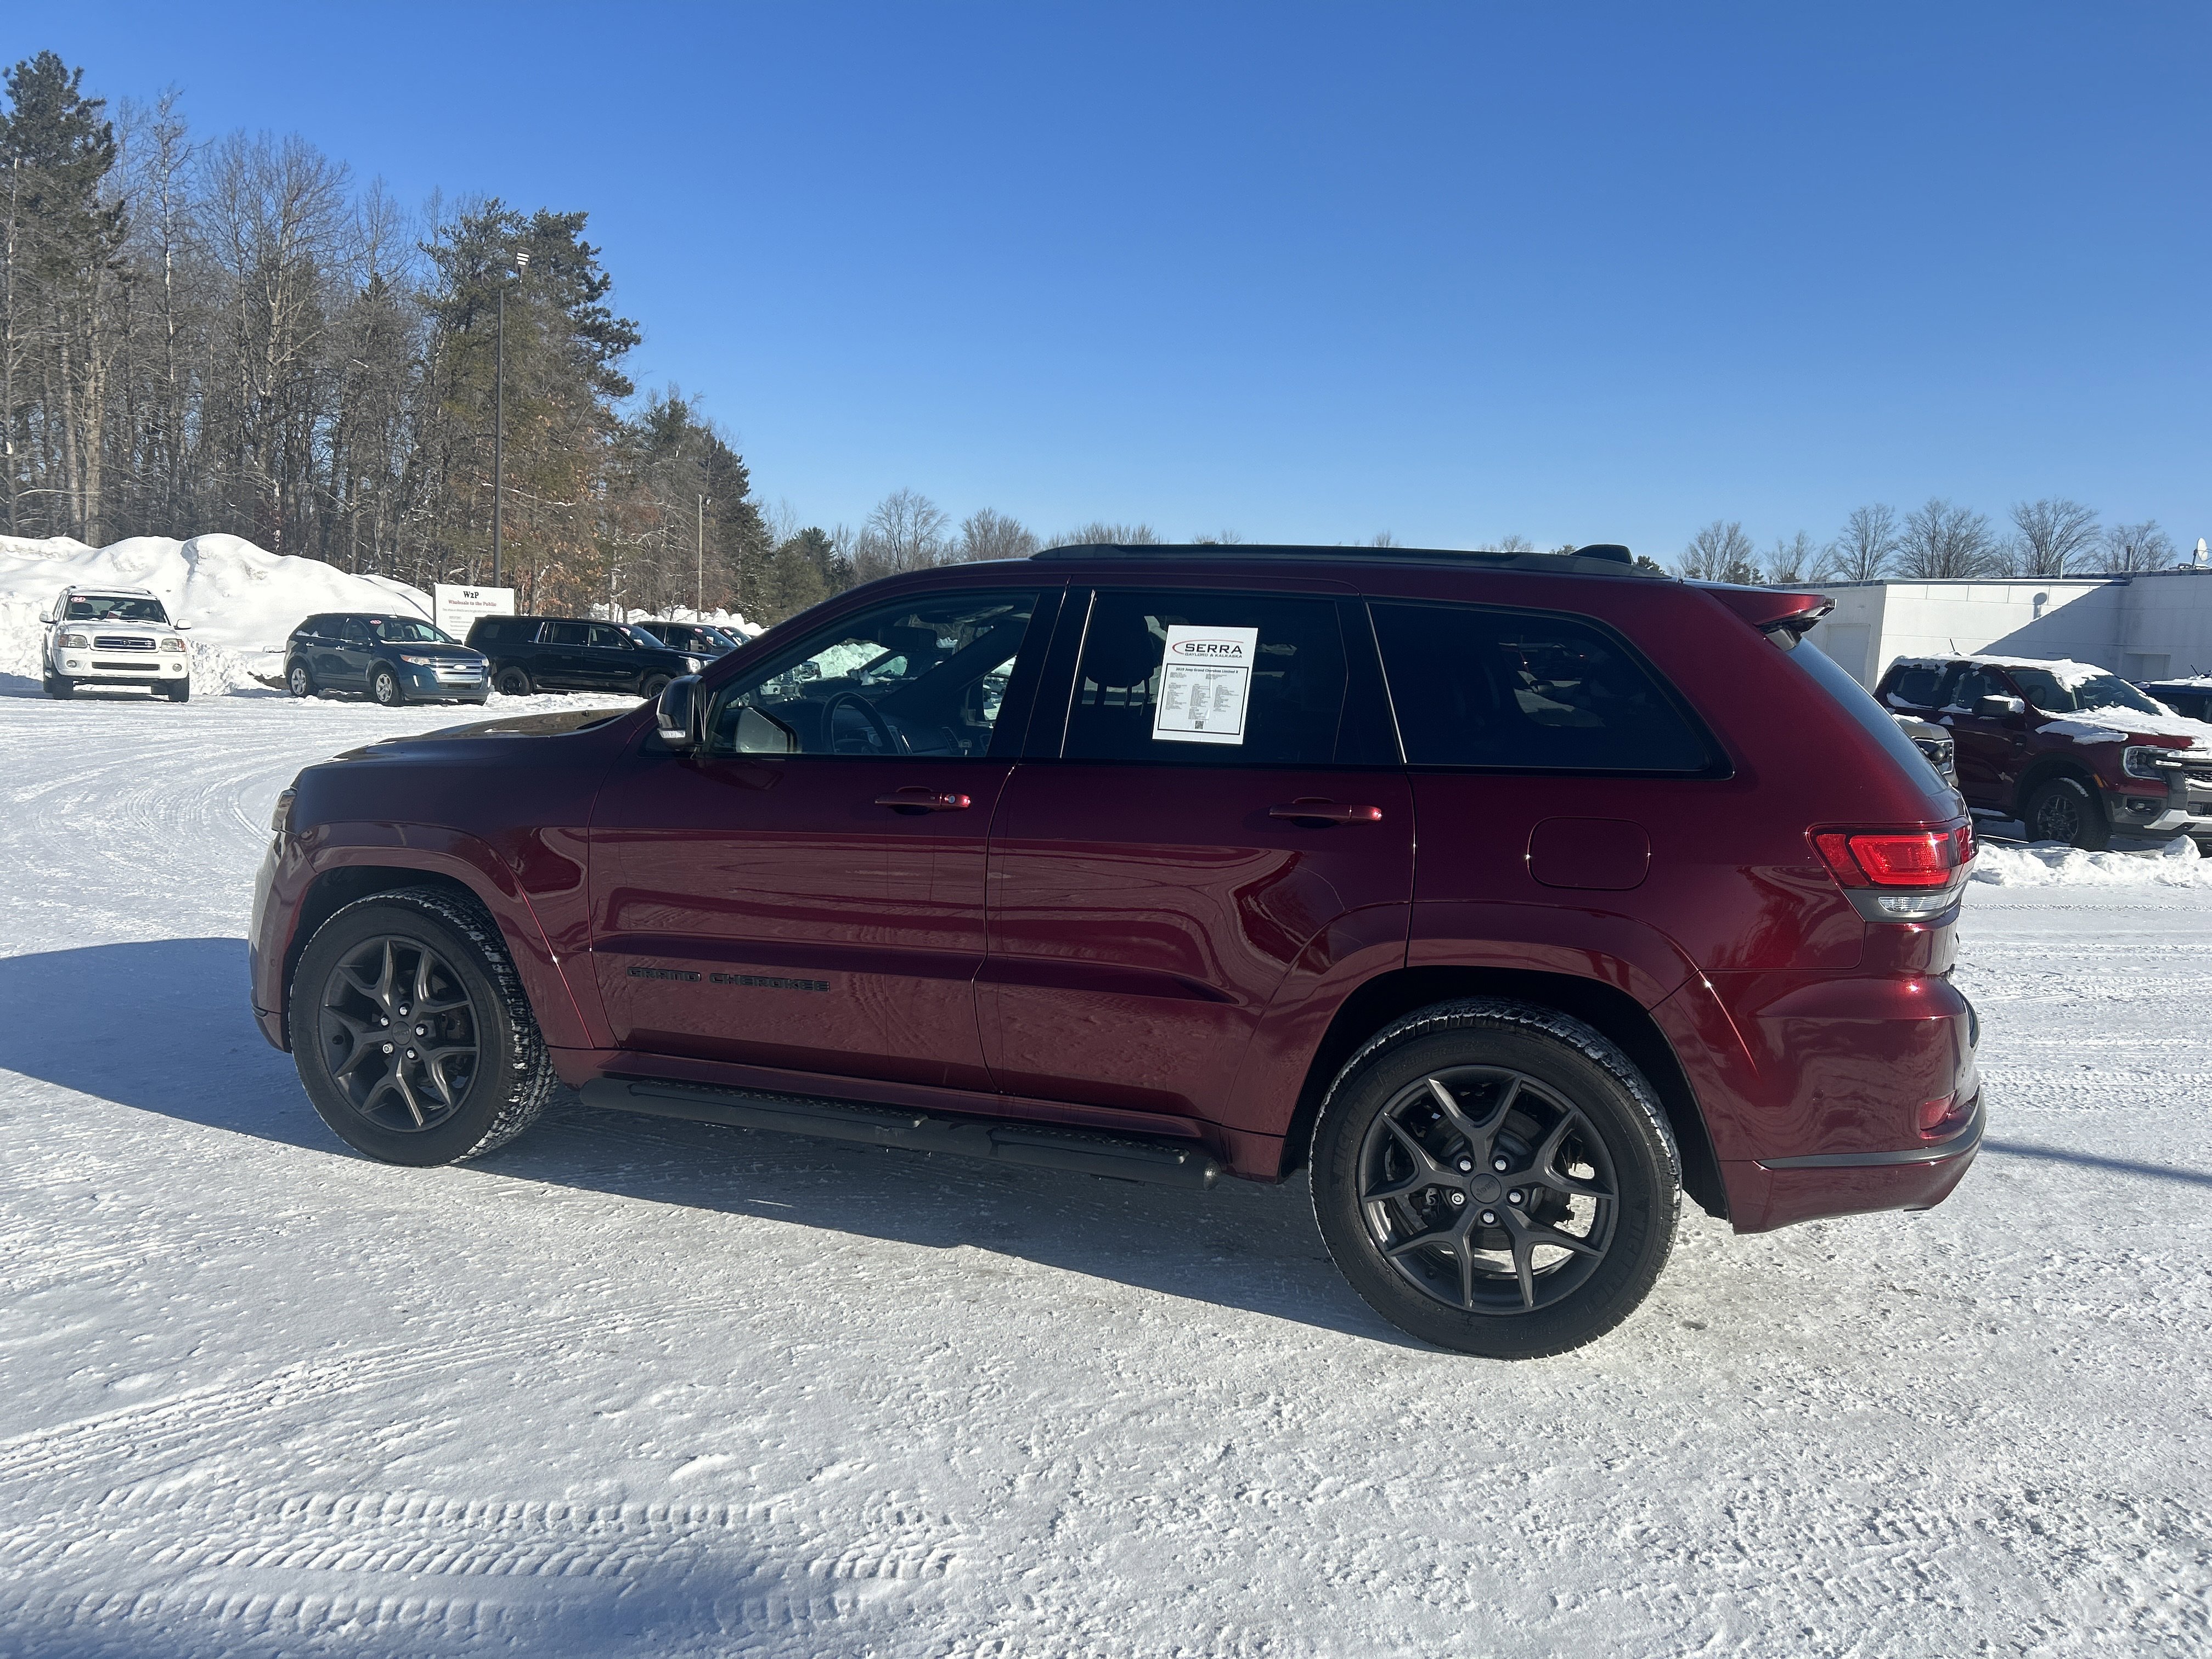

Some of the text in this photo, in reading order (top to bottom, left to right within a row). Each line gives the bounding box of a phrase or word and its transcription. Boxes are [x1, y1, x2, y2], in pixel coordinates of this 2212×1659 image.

[1184, 644, 1243, 654] SERRA
[627, 967, 831, 992] GRAND CHEROKEE
